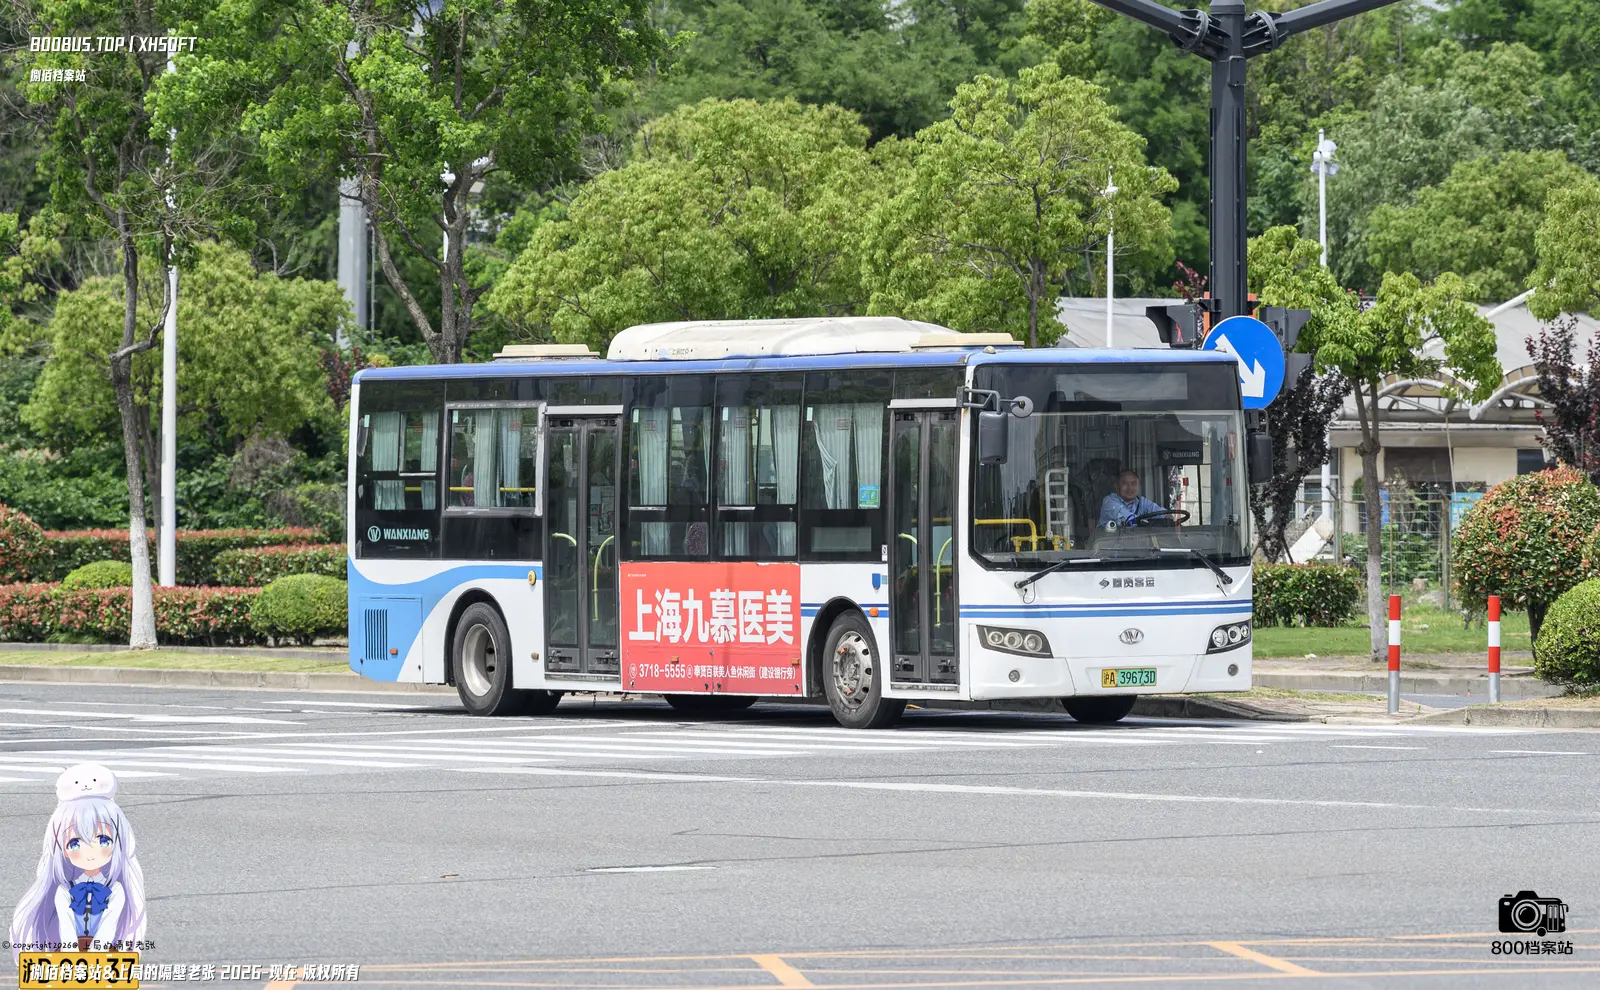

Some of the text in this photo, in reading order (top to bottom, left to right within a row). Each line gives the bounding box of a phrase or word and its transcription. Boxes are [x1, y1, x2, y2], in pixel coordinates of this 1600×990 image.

[383, 528, 430, 540] WANXIANG
[628, 588, 794, 645] 上海九慕医美
[639, 663, 686, 679] 3718-5555
